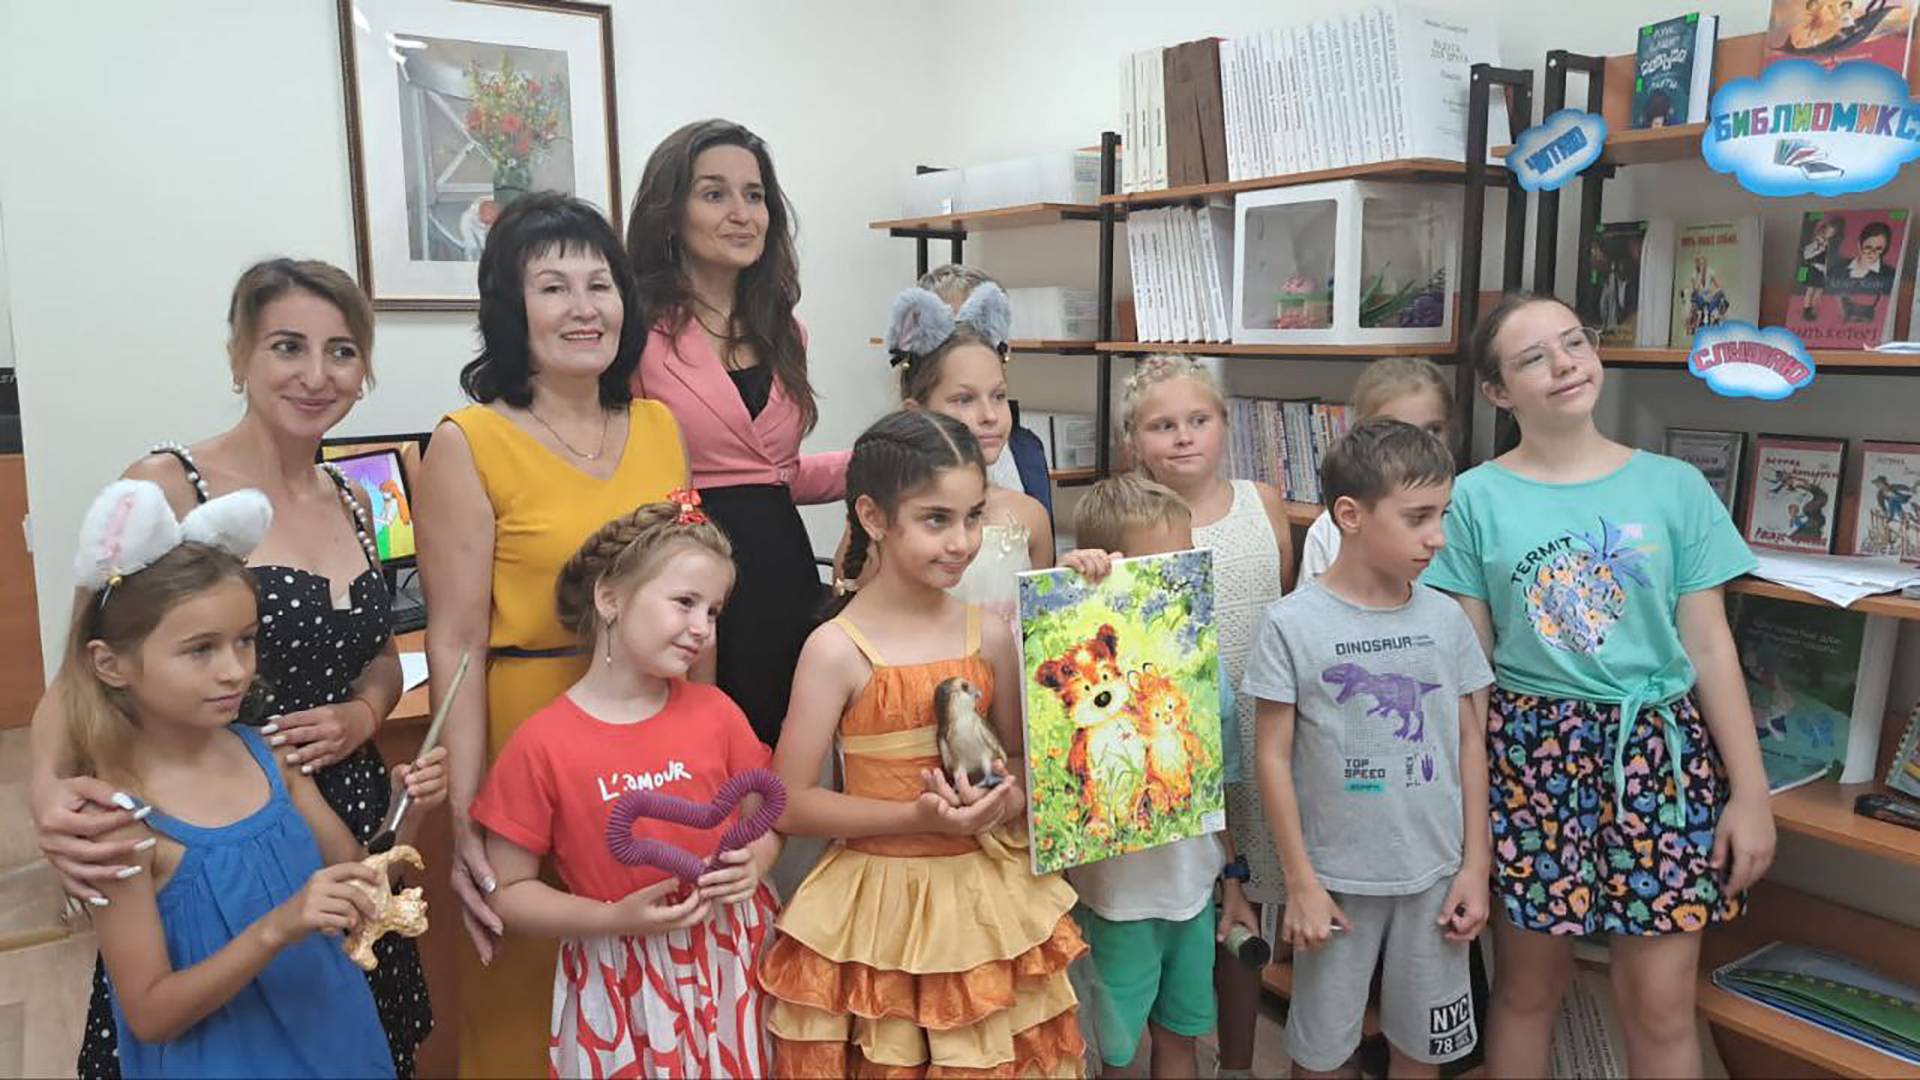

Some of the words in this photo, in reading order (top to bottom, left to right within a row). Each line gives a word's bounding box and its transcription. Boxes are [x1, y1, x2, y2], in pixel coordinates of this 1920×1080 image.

[1510, 536, 1573, 585] TERMIT
[1335, 636, 1413, 656] DINOSAUR
[1344, 758, 1370, 769] TOP
[1344, 768, 1386, 779] SPEED
[1433, 997, 1468, 1032] NYC
[1434, 1038, 1453, 1054] 78
